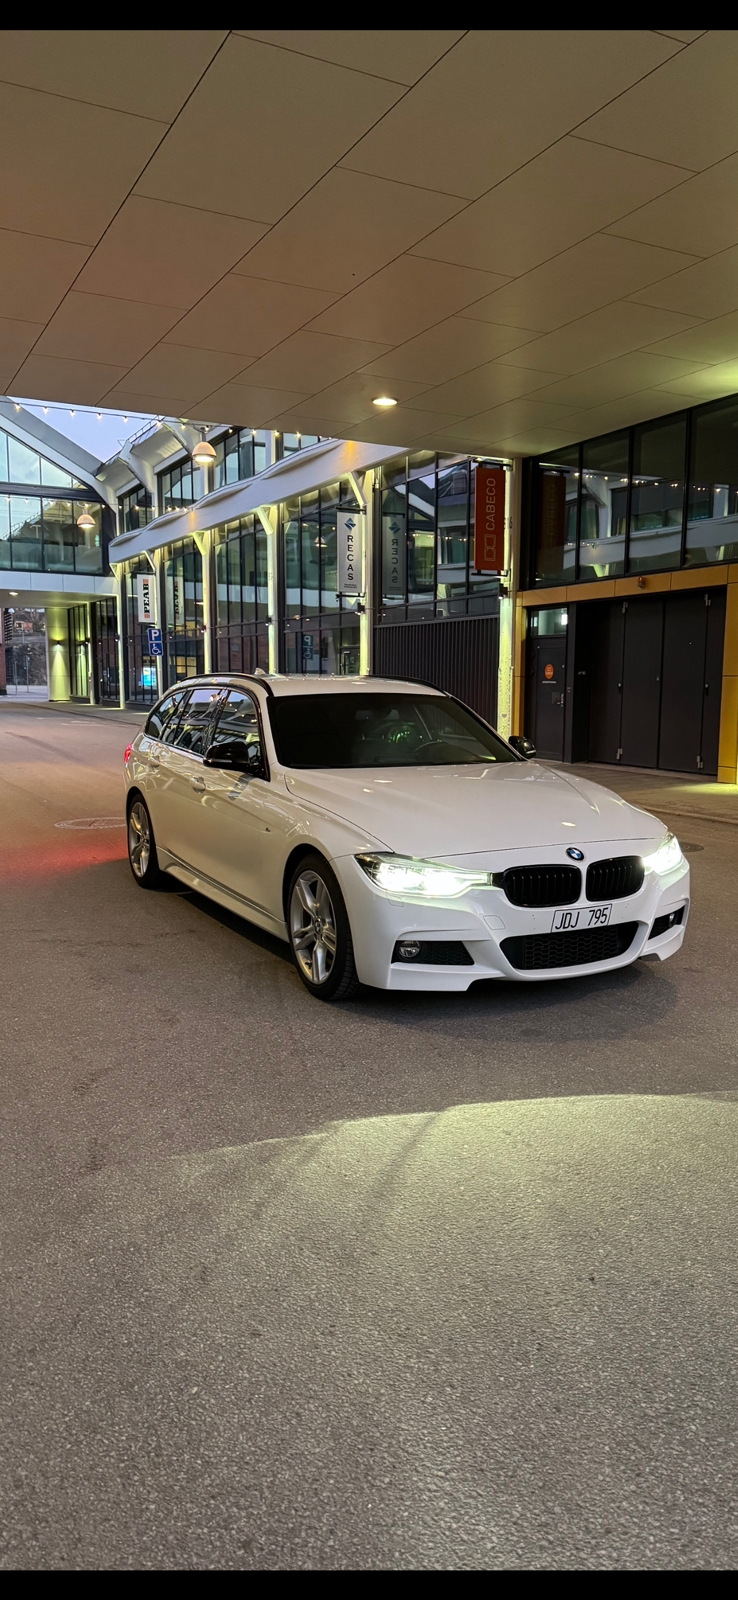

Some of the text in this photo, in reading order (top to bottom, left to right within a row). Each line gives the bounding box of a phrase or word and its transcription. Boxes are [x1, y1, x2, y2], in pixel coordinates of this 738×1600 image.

[485, 477, 496, 531] CABECO
[346, 534, 354, 581] RECAS
[151, 629, 159, 641] P
[555, 907, 609, 930] JDJ 795
